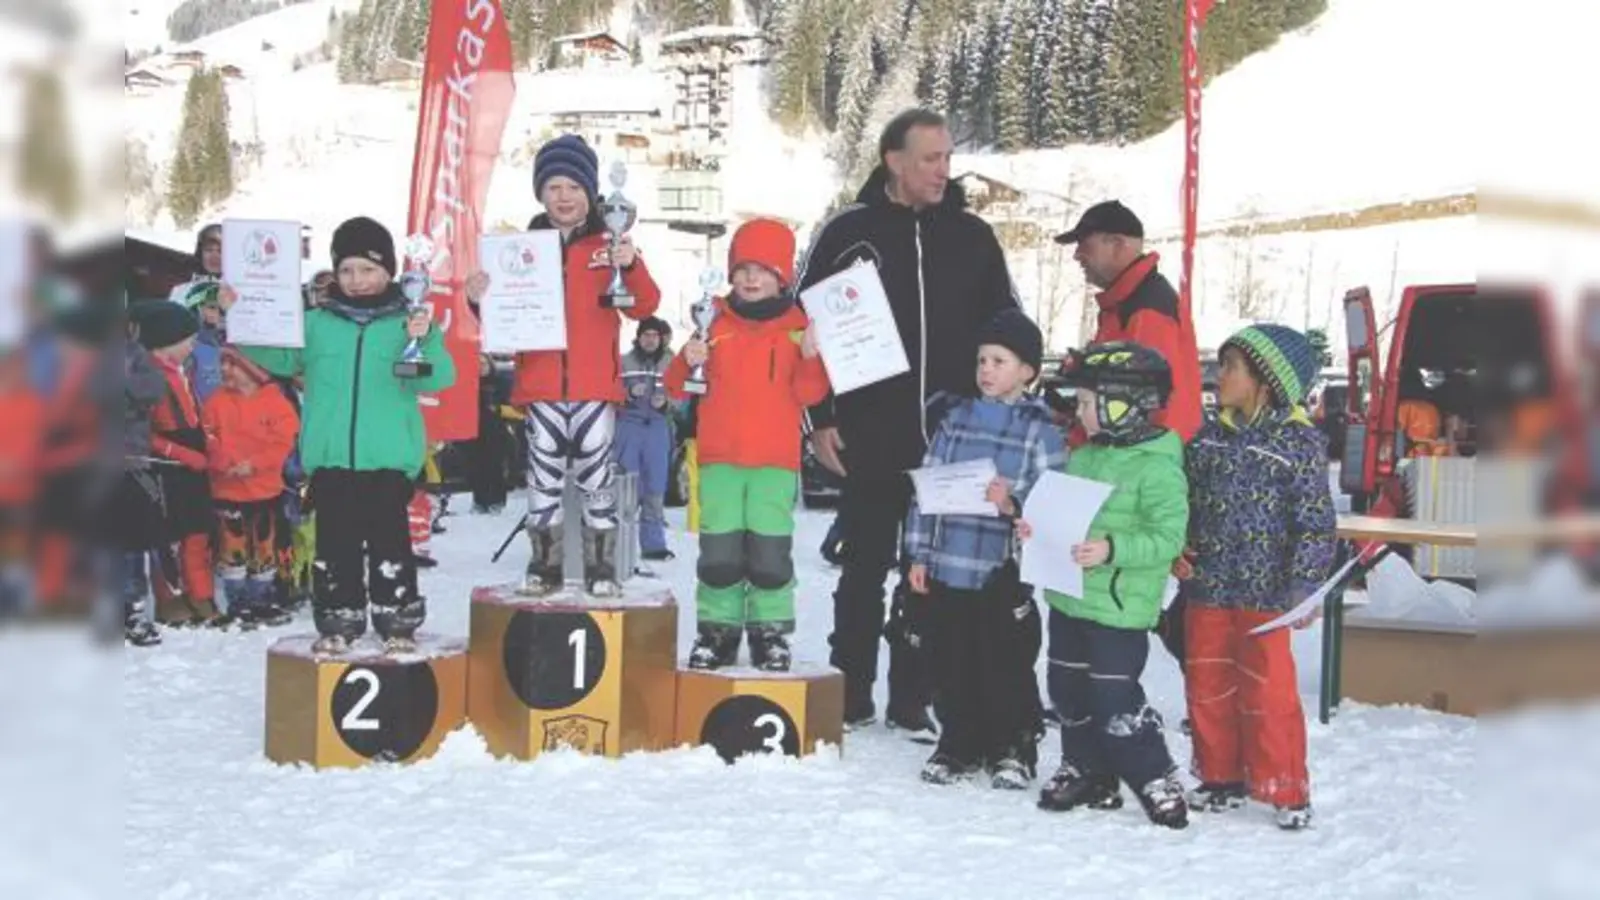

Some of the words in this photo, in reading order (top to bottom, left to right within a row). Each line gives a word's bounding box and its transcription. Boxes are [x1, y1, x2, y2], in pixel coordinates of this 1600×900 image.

[567, 628, 587, 690] 1
[341, 668, 381, 730] 2
[753, 713, 785, 755] 3
